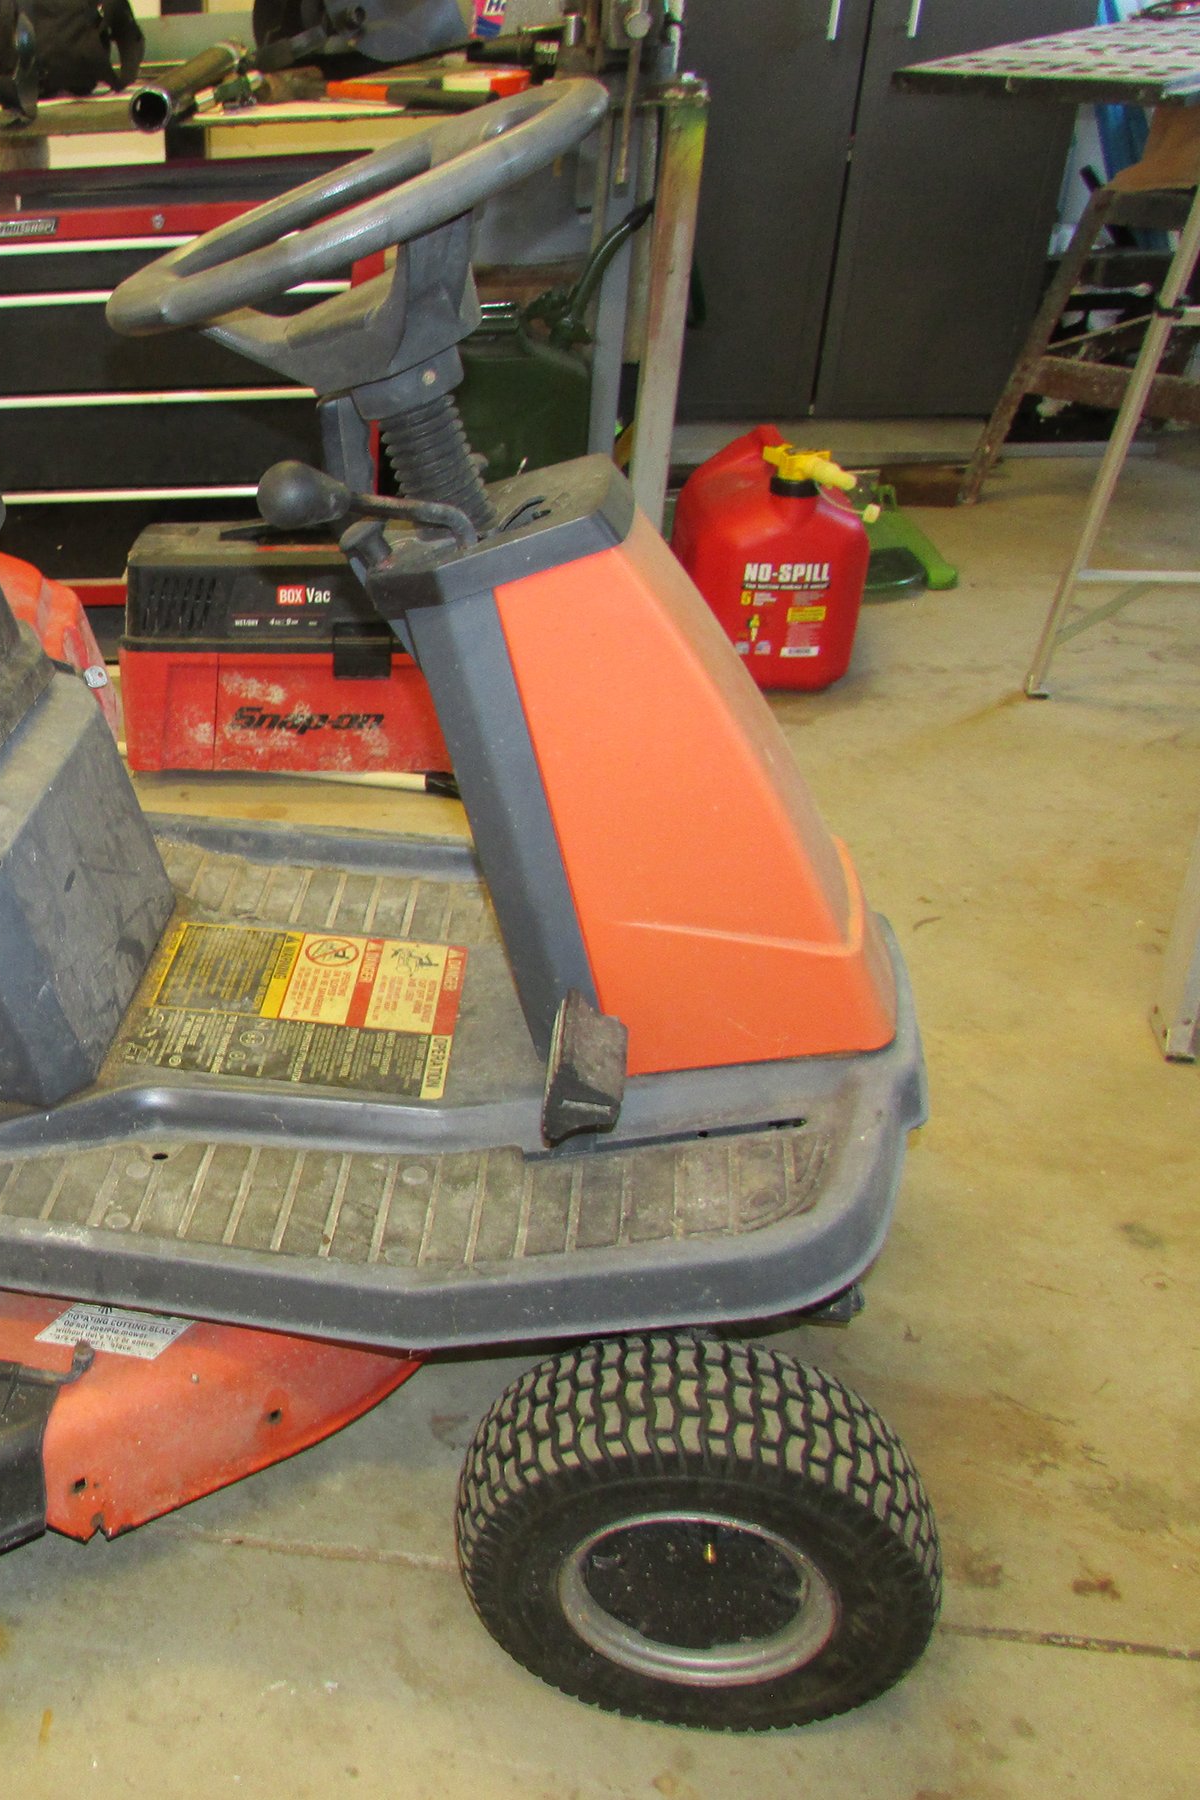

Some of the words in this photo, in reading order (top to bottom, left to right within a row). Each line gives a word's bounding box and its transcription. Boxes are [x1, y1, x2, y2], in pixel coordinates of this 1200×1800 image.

[743, 563, 830, 583] NO-SPILL
[279, 588, 303, 604] BOX
[306, 587, 331, 604] Vac
[230, 706, 385, 735] Snap-on
[272, 945, 297, 979] WARNING
[424, 1036, 448, 1089] OPERATION
[75, 1321, 88, 1330] not
[120, 1330, 147, 1339] mower
[110, 1319, 146, 1332] CUTTING
